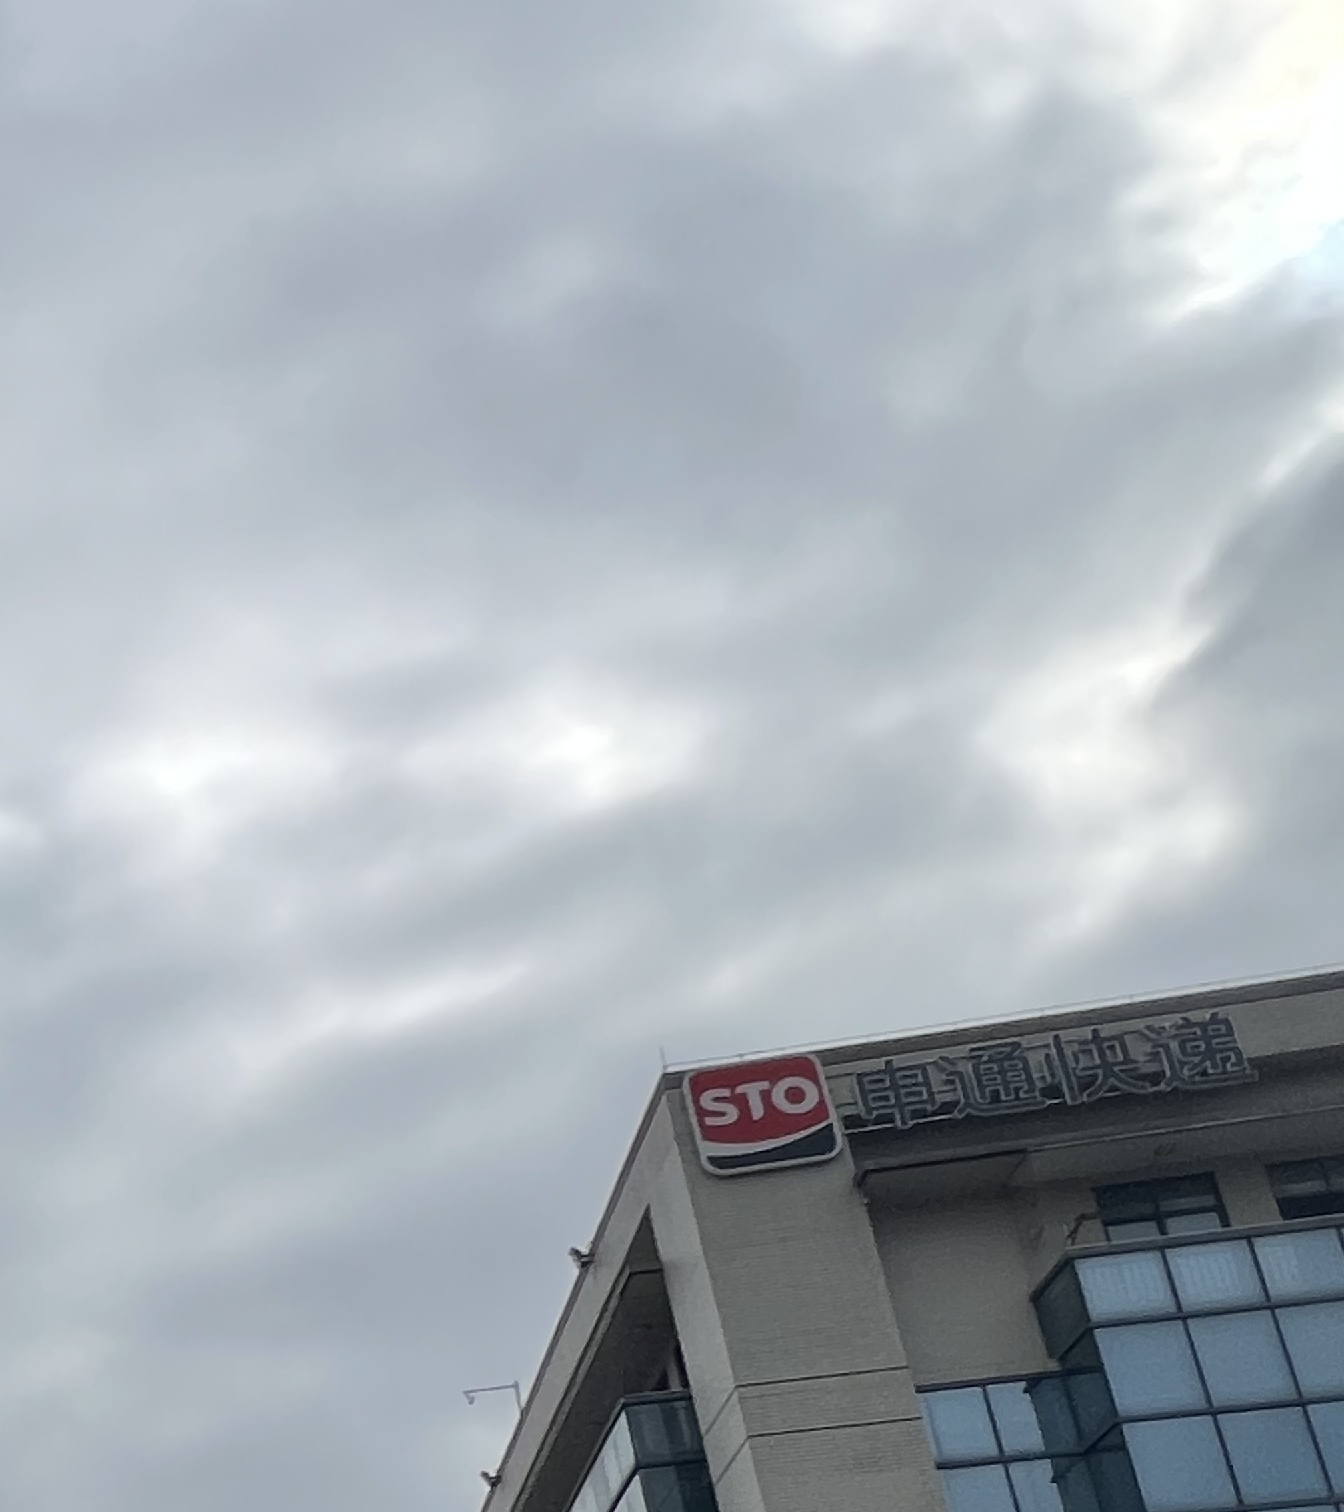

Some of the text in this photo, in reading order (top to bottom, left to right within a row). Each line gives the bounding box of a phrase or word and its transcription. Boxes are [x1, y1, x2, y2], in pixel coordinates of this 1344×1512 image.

[697, 1074, 822, 1128] STO
[854, 1012, 1252, 1131] 申通快递
